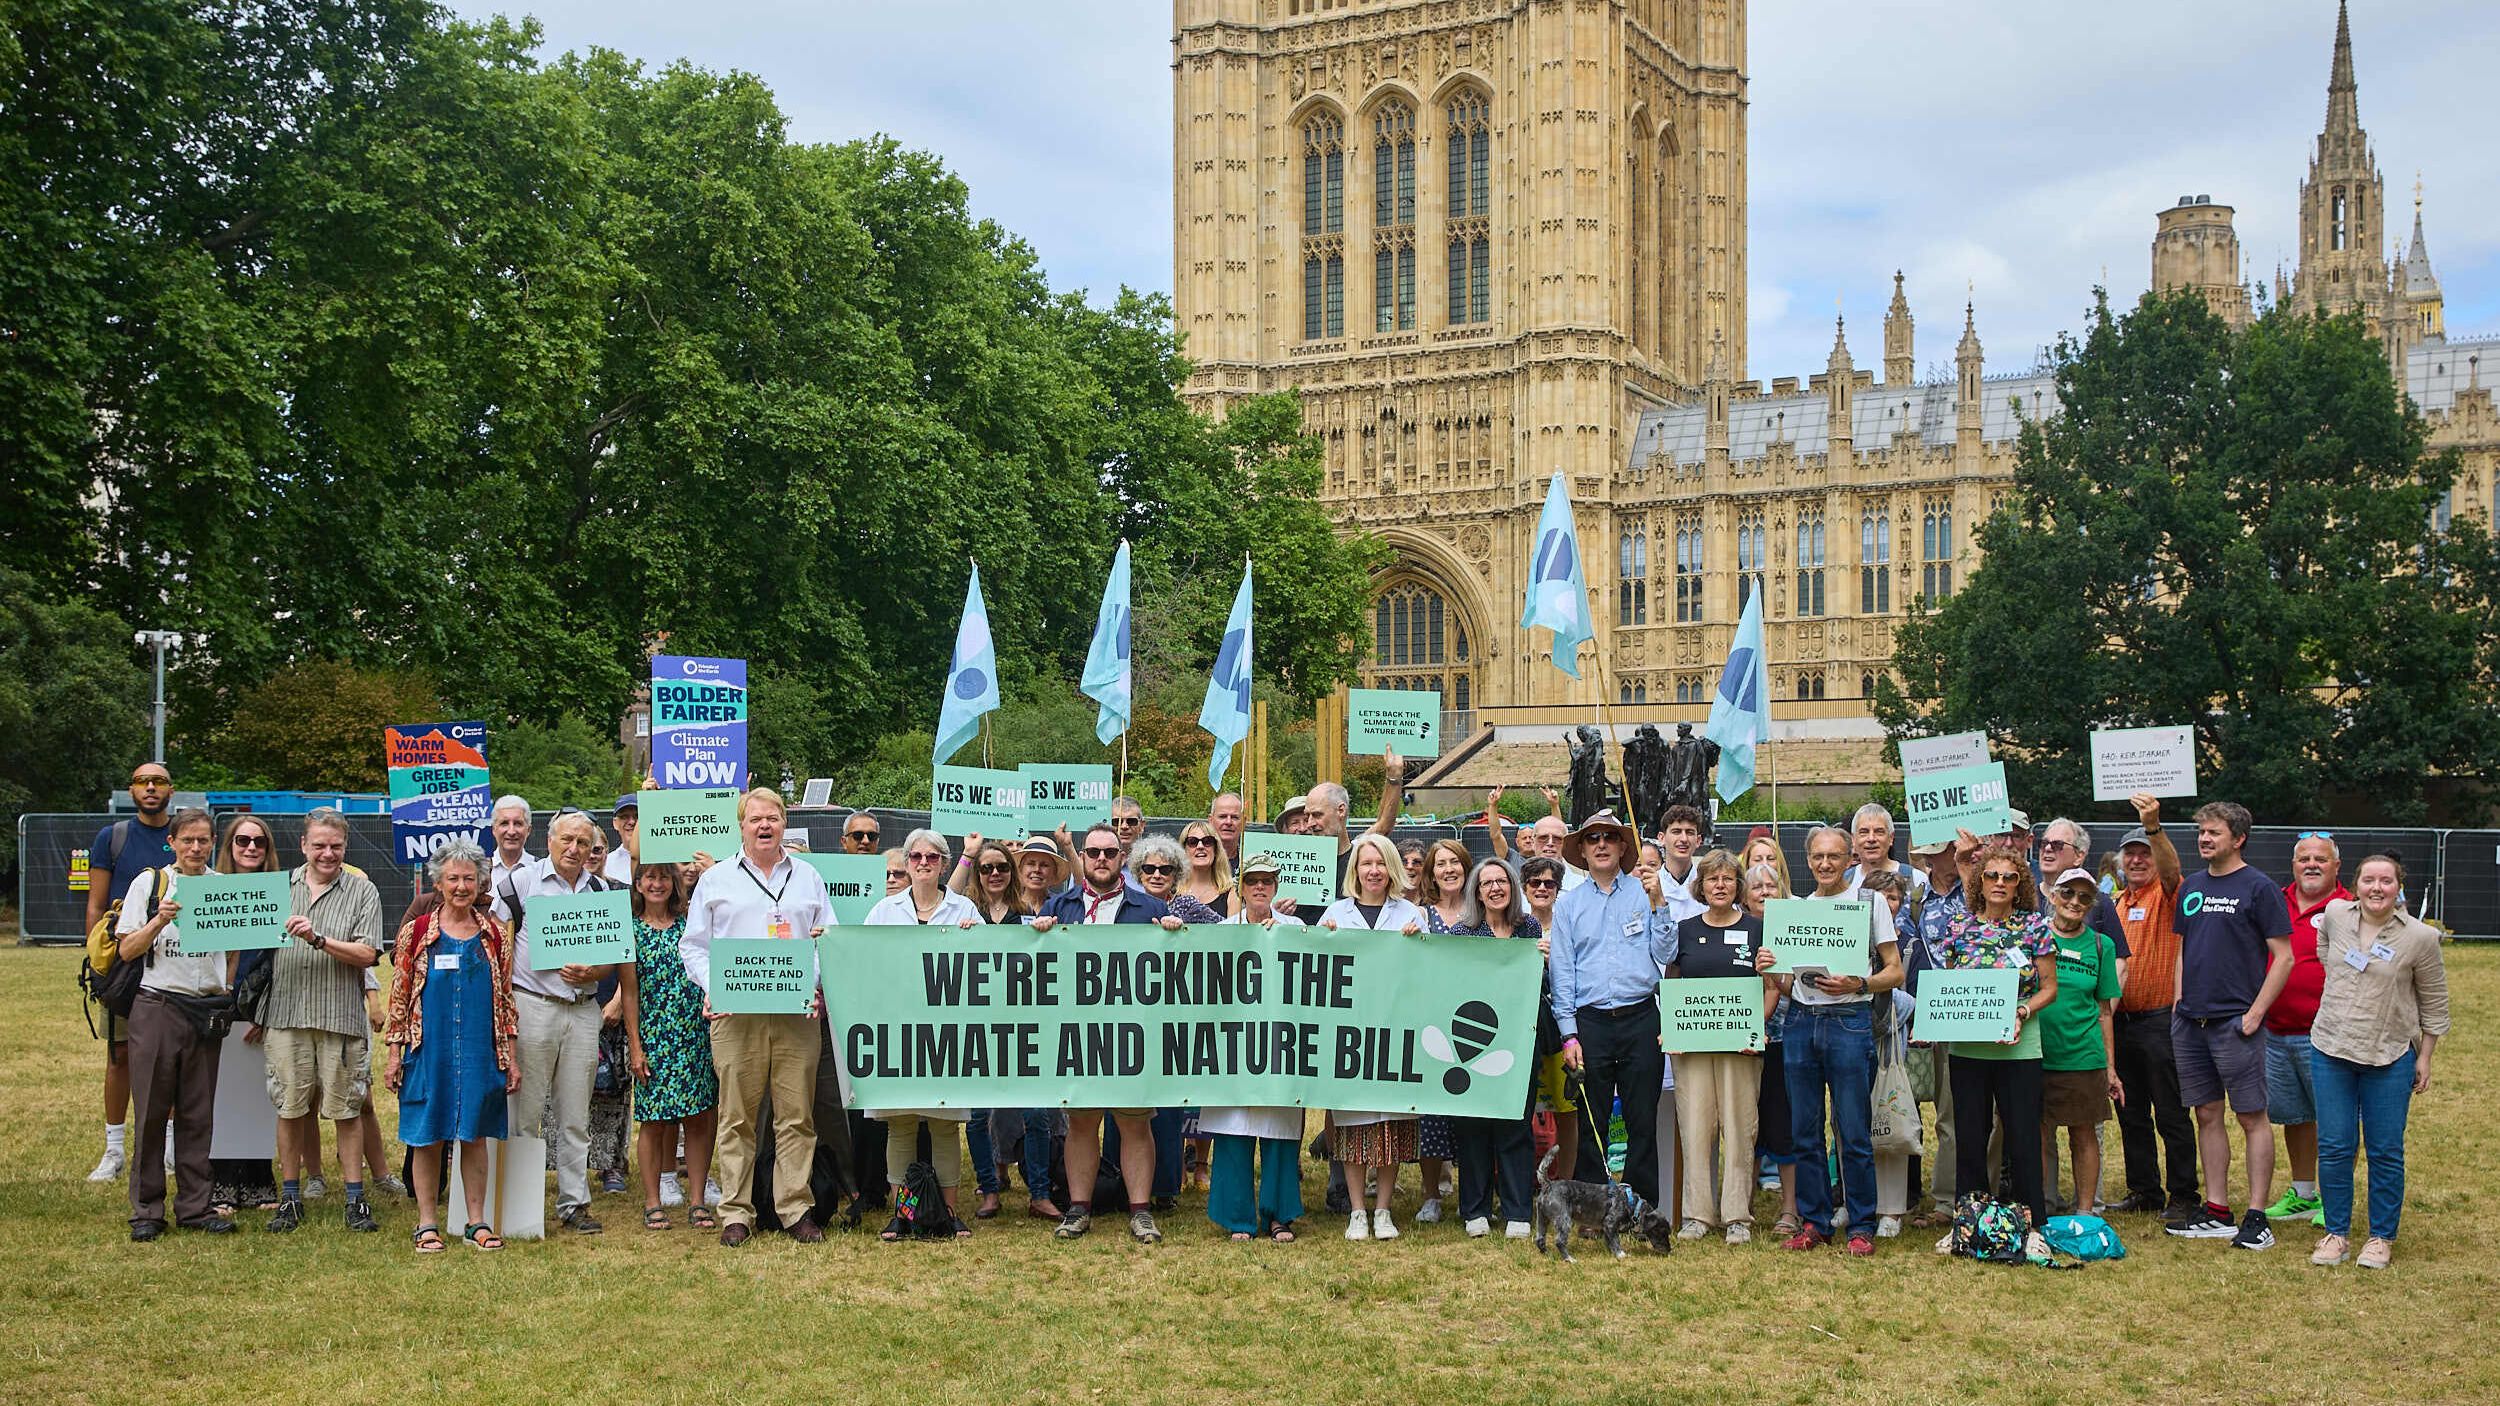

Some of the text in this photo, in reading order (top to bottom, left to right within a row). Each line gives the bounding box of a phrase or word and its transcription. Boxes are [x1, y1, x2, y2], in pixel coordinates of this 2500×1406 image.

[657, 686, 743, 703] BOLDER
[661, 704, 738, 722] FAIRER
[1363, 718, 1398, 727] CLIMATE
[1364, 727, 1415, 736] NATURE BILL
[395, 740, 444, 751] WARM
[670, 732, 729, 747] Climate
[392, 752, 447, 764] HOMES
[685, 748, 716, 761] Plan
[412, 768, 465, 783] GREEN
[665, 761, 738, 785] NOW
[420, 780, 460, 795] JOBS
[1031, 781, 1109, 800] ES WE CAN
[431, 793, 484, 807] CLEAN
[937, 782, 1026, 808] YES WE CAN
[1910, 780, 2004, 813] YES WE CAN
[427, 806, 489, 821] ENERGY
[663, 814, 717, 825] RESTORE
[650, 825, 730, 837] NATURE NOW
[405, 829, 481, 859] NOW
[1294, 852, 1317, 860] THE
[1303, 864, 1326, 873] AND
[1300, 876, 1324, 886] BILL
[830, 882, 860, 896] HOUR
[204, 890, 267, 902] BACK THE
[2204, 896, 2229, 904] Friends
[194, 904, 278, 916] CLIMATE AND
[2202, 904, 2236, 914] the Earth
[552, 909, 610, 922] BACK THE
[196, 916, 278, 930] NATURE BILL
[542, 921, 621, 935] CLIMATE AND
[1788, 926, 1844, 936] RESTORE
[545, 934, 620, 948] NATURE BILL
[1774, 937, 1856, 948] NATURE NOW
[735, 956, 793, 966] BACK THE
[724, 970, 804, 978] CLIMATE AND
[922, 950, 1354, 1008] WE'RE BACKING THE
[726, 982, 802, 992] NATURE BILL
[1940, 986, 1996, 994] BACK THE
[1685, 996, 1742, 1005] BACK THE
[1929, 998, 2005, 1008] CLIMATE AND
[1674, 1008, 1752, 1018] CLIMATE AND
[1930, 1011, 2002, 1020] NATURE BILL
[1677, 1021, 1751, 1030] NATURE BILL
[848, 1022, 1424, 1084] CLIMATE AND NATURE BILL
